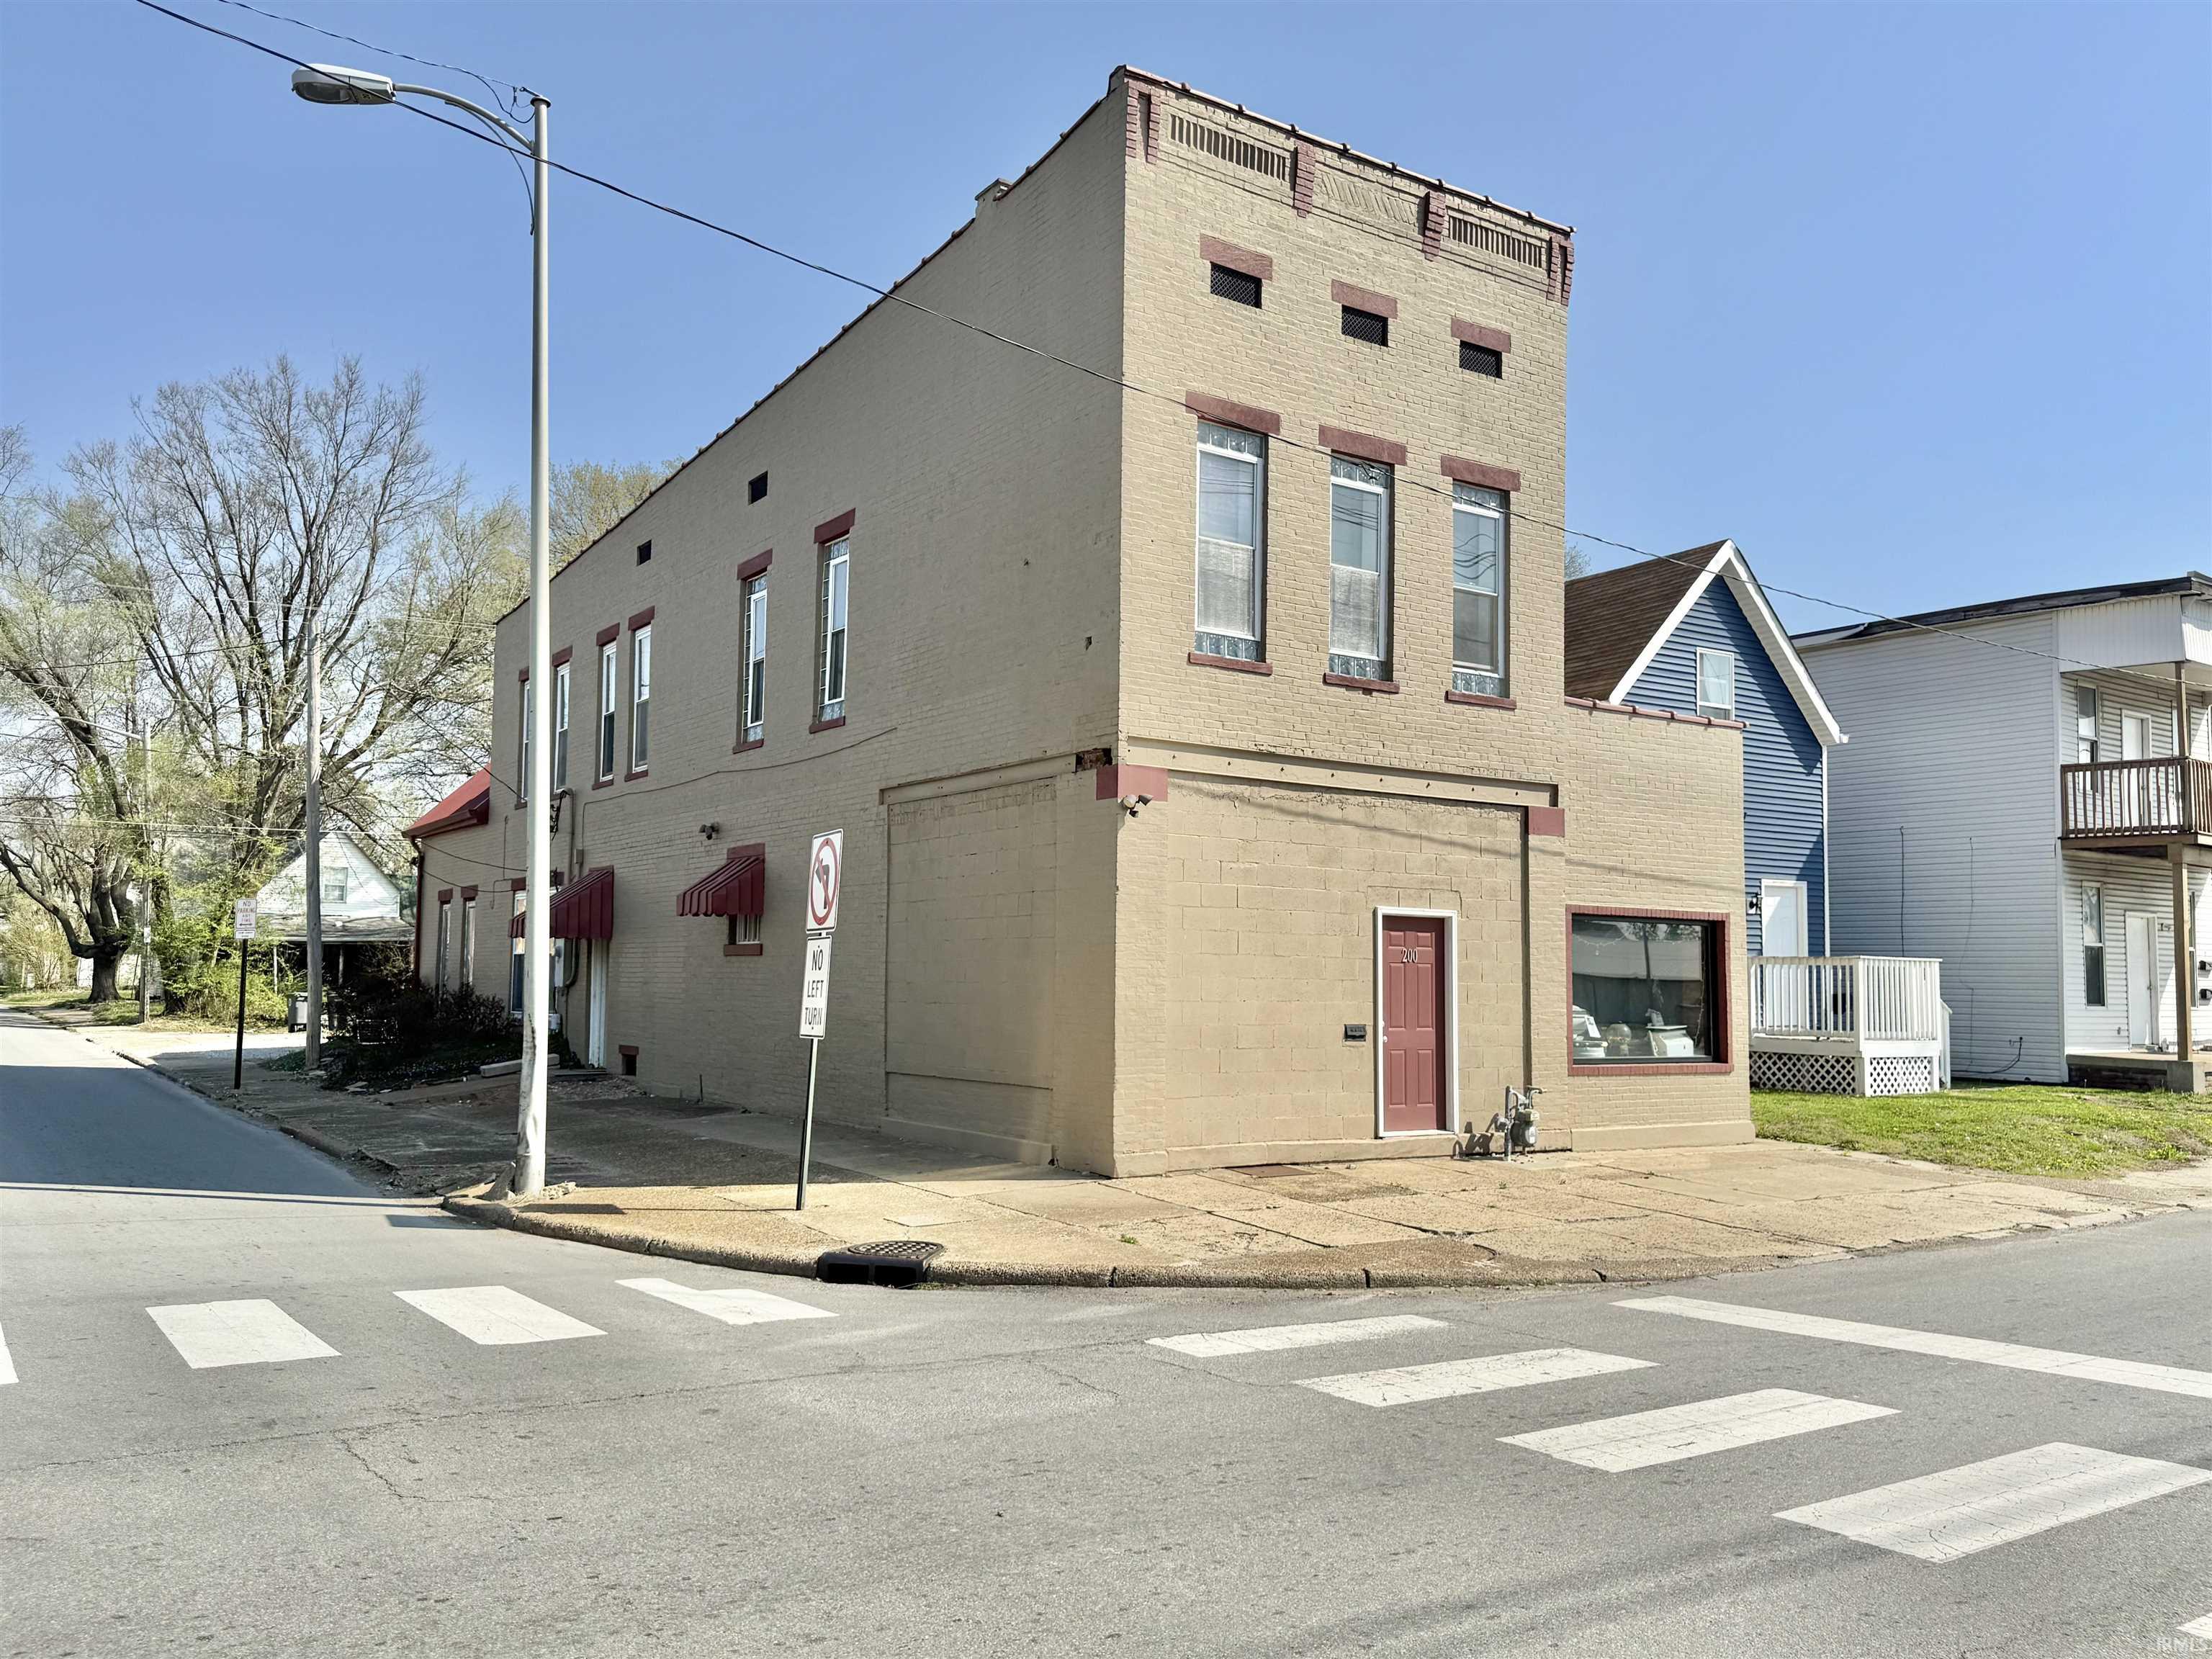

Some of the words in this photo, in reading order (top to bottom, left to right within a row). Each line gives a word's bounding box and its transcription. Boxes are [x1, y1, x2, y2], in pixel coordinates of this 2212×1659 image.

[811, 949, 823, 971] NO
[1401, 948, 1418, 962] 200
[807, 980, 824, 998] LEFT
[805, 1007, 822, 1025] TURN
